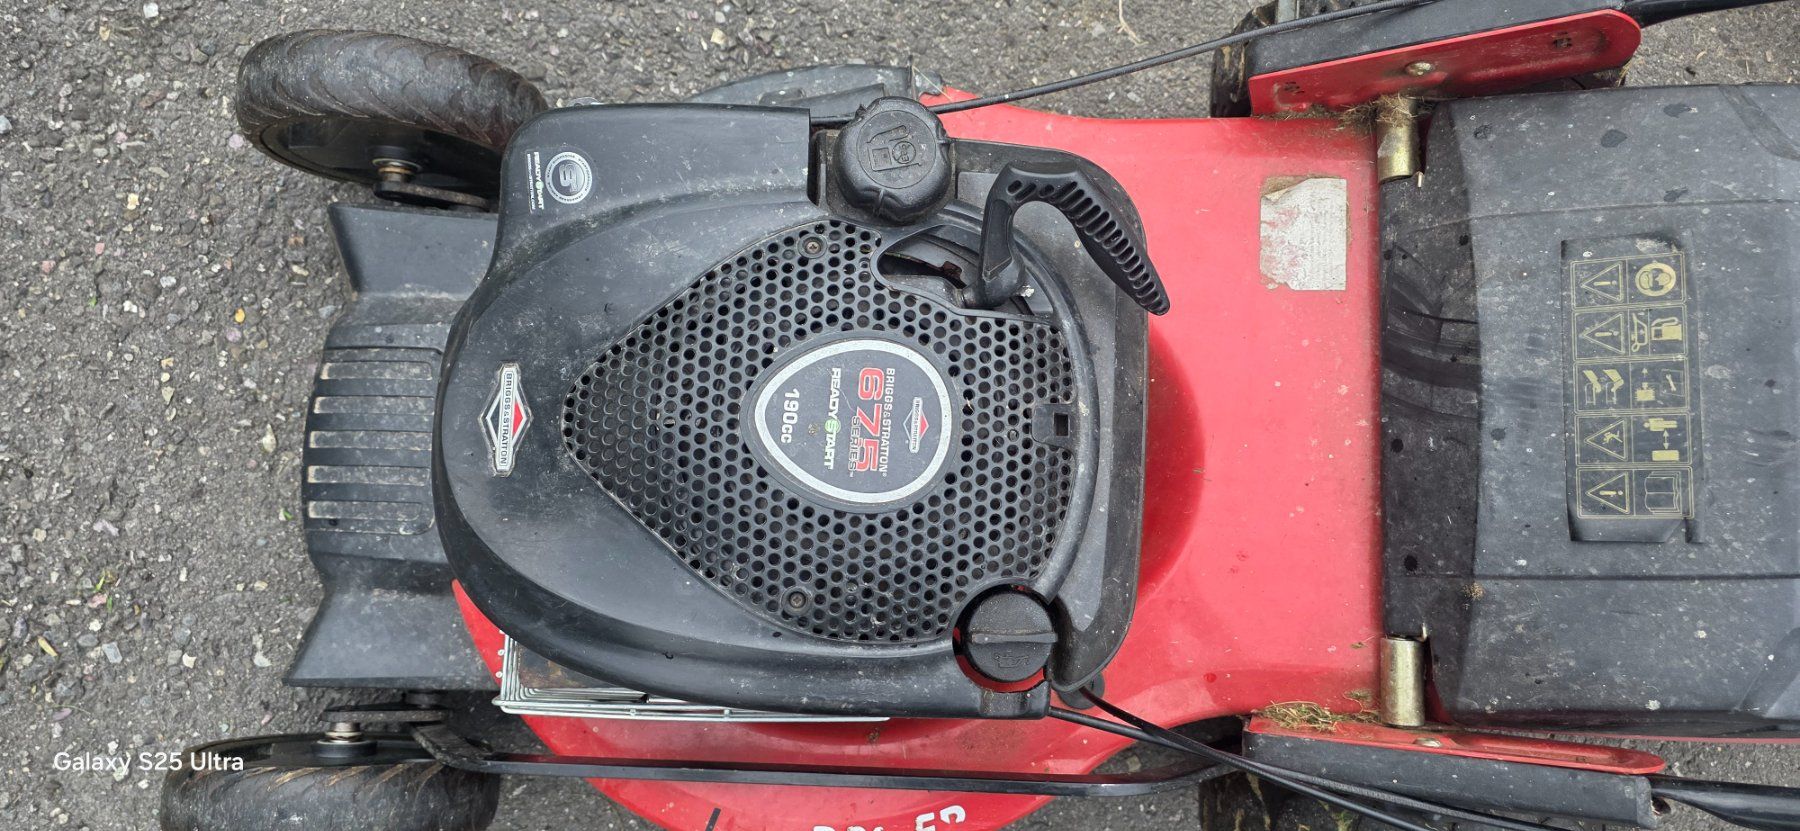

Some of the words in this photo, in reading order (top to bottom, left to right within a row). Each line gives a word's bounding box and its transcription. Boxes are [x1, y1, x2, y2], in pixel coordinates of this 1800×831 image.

[500, 372, 513, 464] BRIGGS&STRATTON
[781, 388, 800, 444] 190cc
[824, 367, 841, 470] READYSTART
[857, 367, 884, 472] 675
